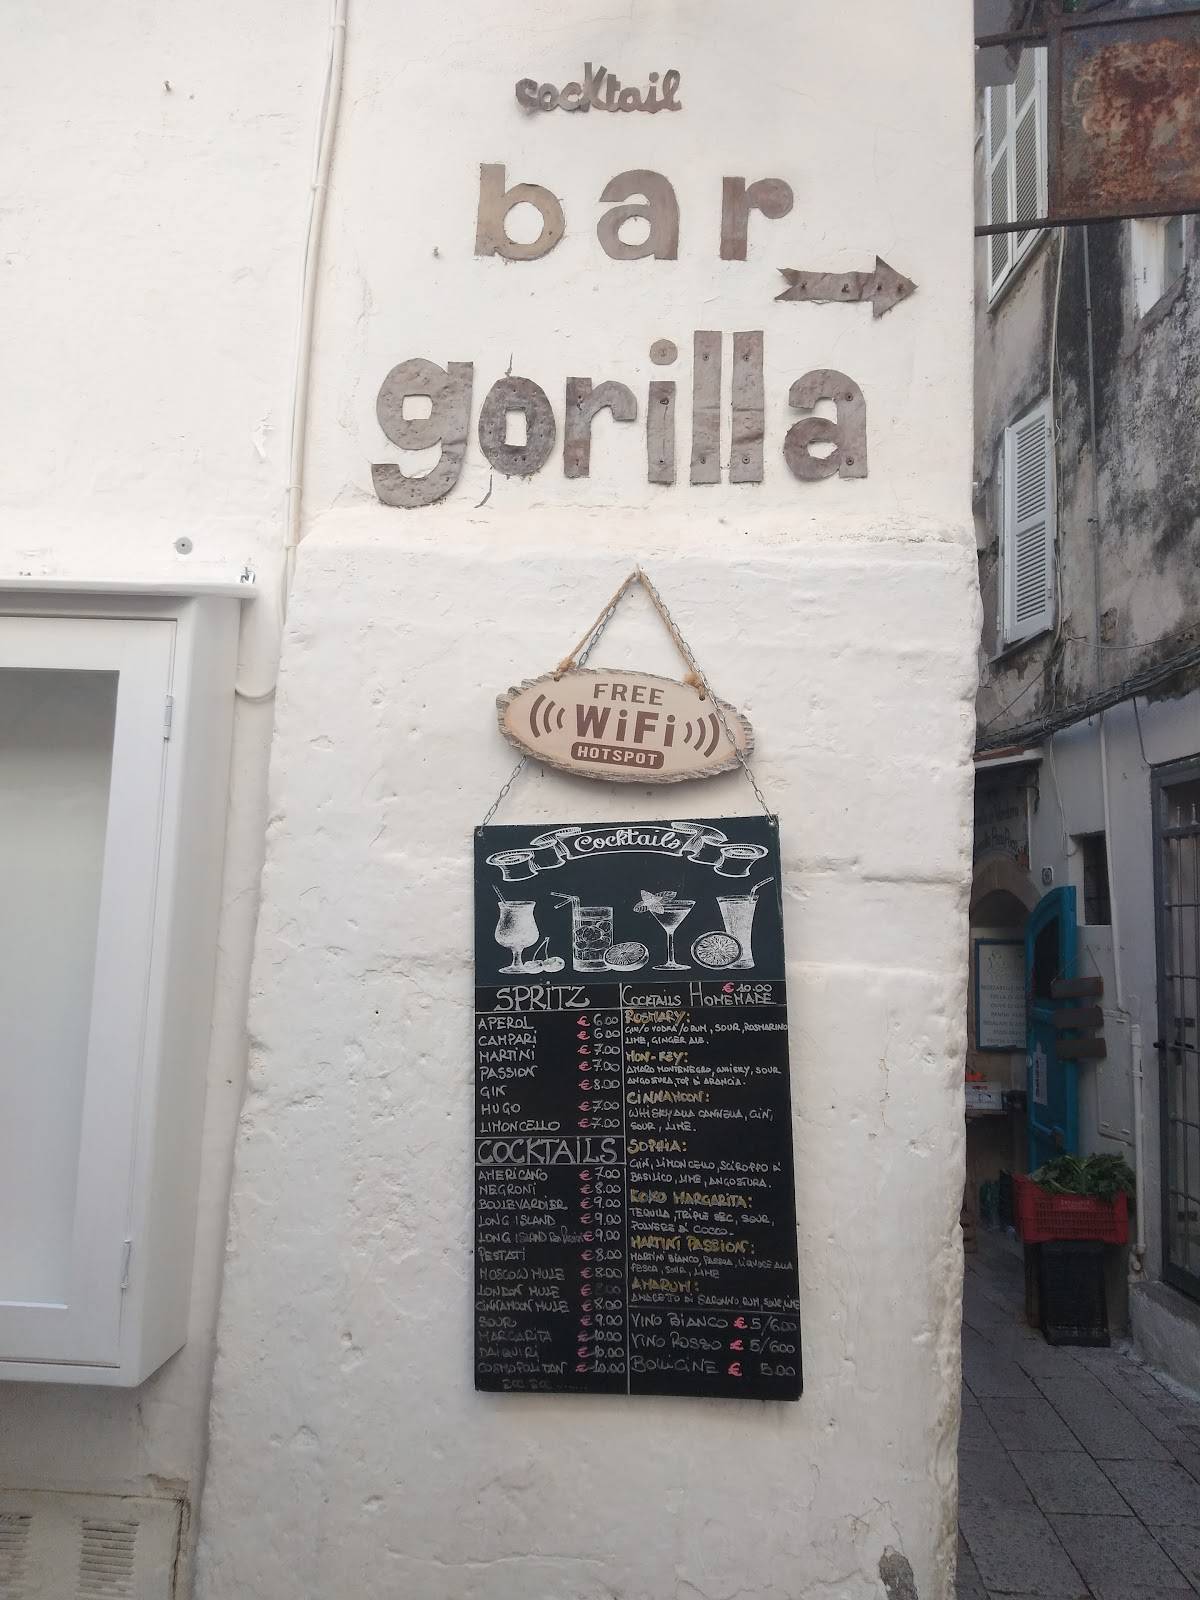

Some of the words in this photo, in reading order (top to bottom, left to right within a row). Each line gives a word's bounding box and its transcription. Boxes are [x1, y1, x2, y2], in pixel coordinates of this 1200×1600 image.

[515, 62, 682, 114] cocktail
[474, 163, 794, 261] bar
[371, 331, 867, 508] gorilla
[593, 683, 665, 707] FREE
[576, 703, 677, 747] WiFi
[576, 745, 658, 767] HOTSPOT
[575, 829, 684, 853] Cocktails
[478, 1016, 534, 1030] APEROL
[481, 1102, 521, 1115] HUGO
[480, 1120, 561, 1133] LIMONCELLO
[478, 1137, 618, 1164] COCKTAILS
[632, 1313, 662, 1327] VINO
[631, 1333, 666, 1349] VINO
[670, 1331, 722, 1351] ROSSO
